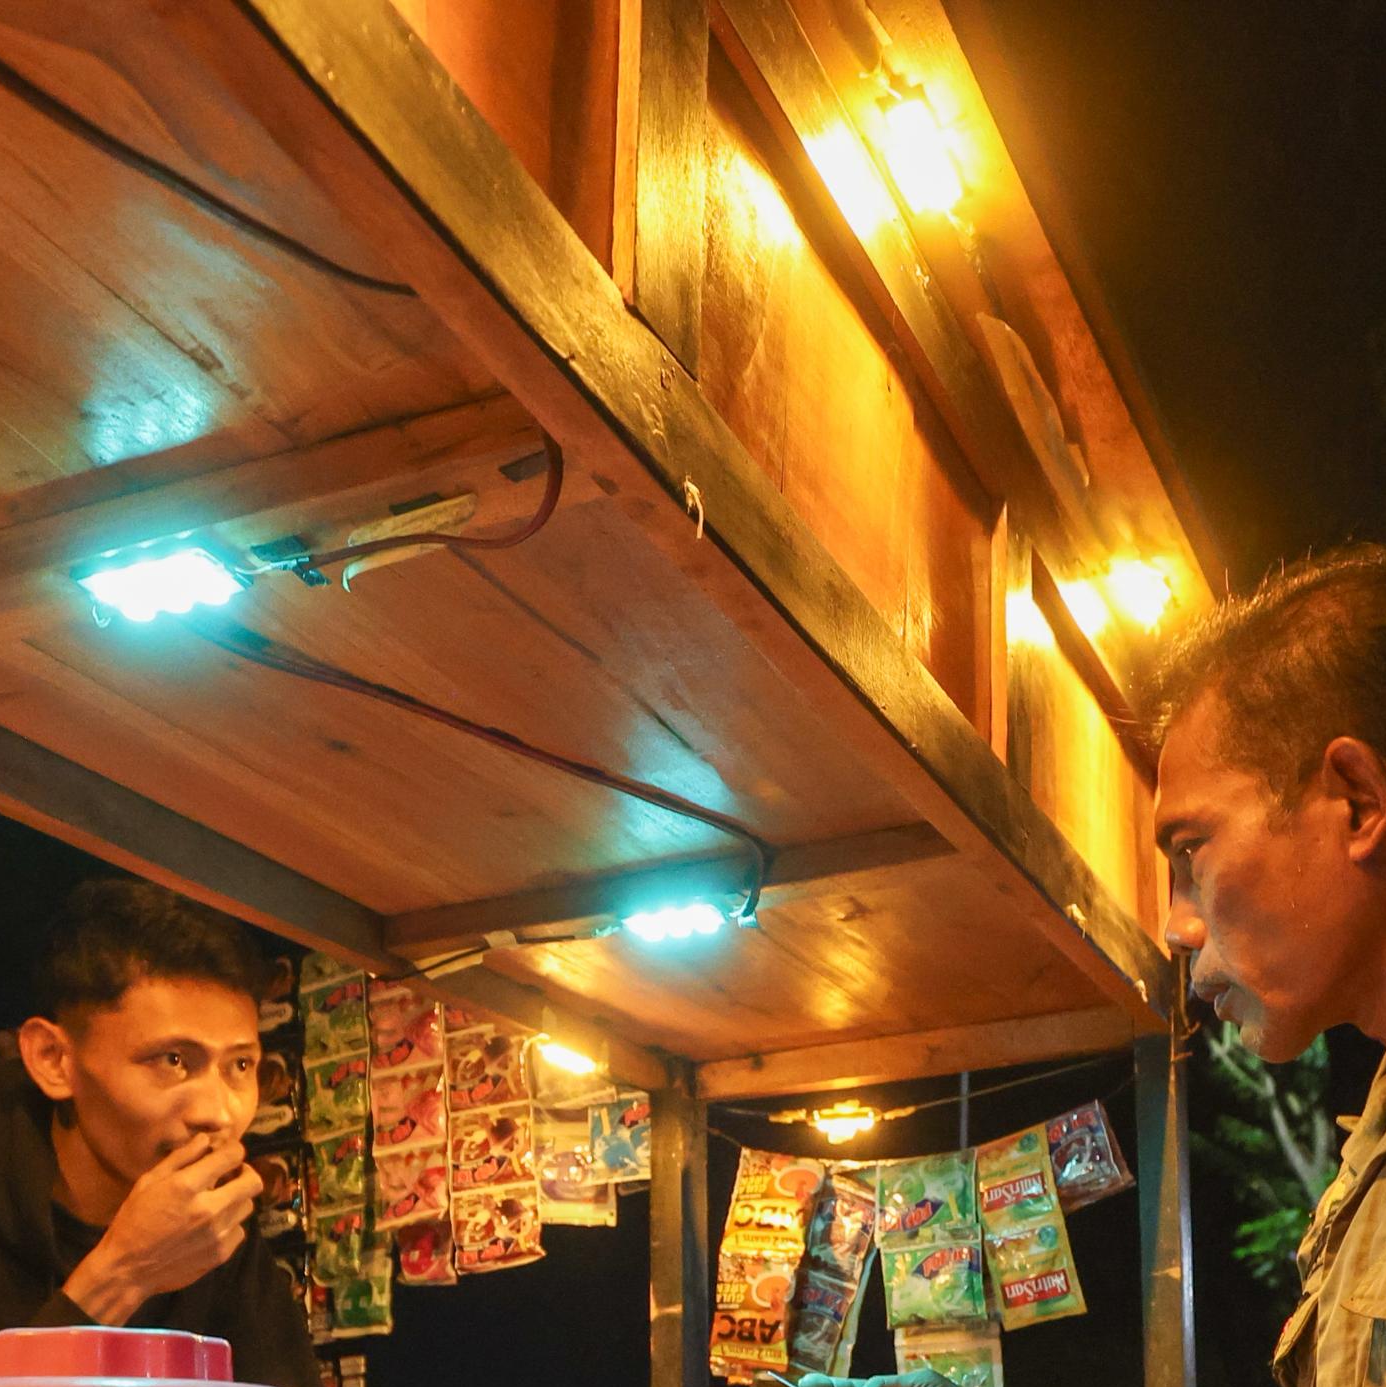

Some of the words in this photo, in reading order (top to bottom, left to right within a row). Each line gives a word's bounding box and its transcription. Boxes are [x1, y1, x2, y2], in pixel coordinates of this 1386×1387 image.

[983, 1174, 1044, 1207] NutriSari
[1004, 1271, 1068, 1302] NutriSari
[717, 1315, 782, 1345] ABC
